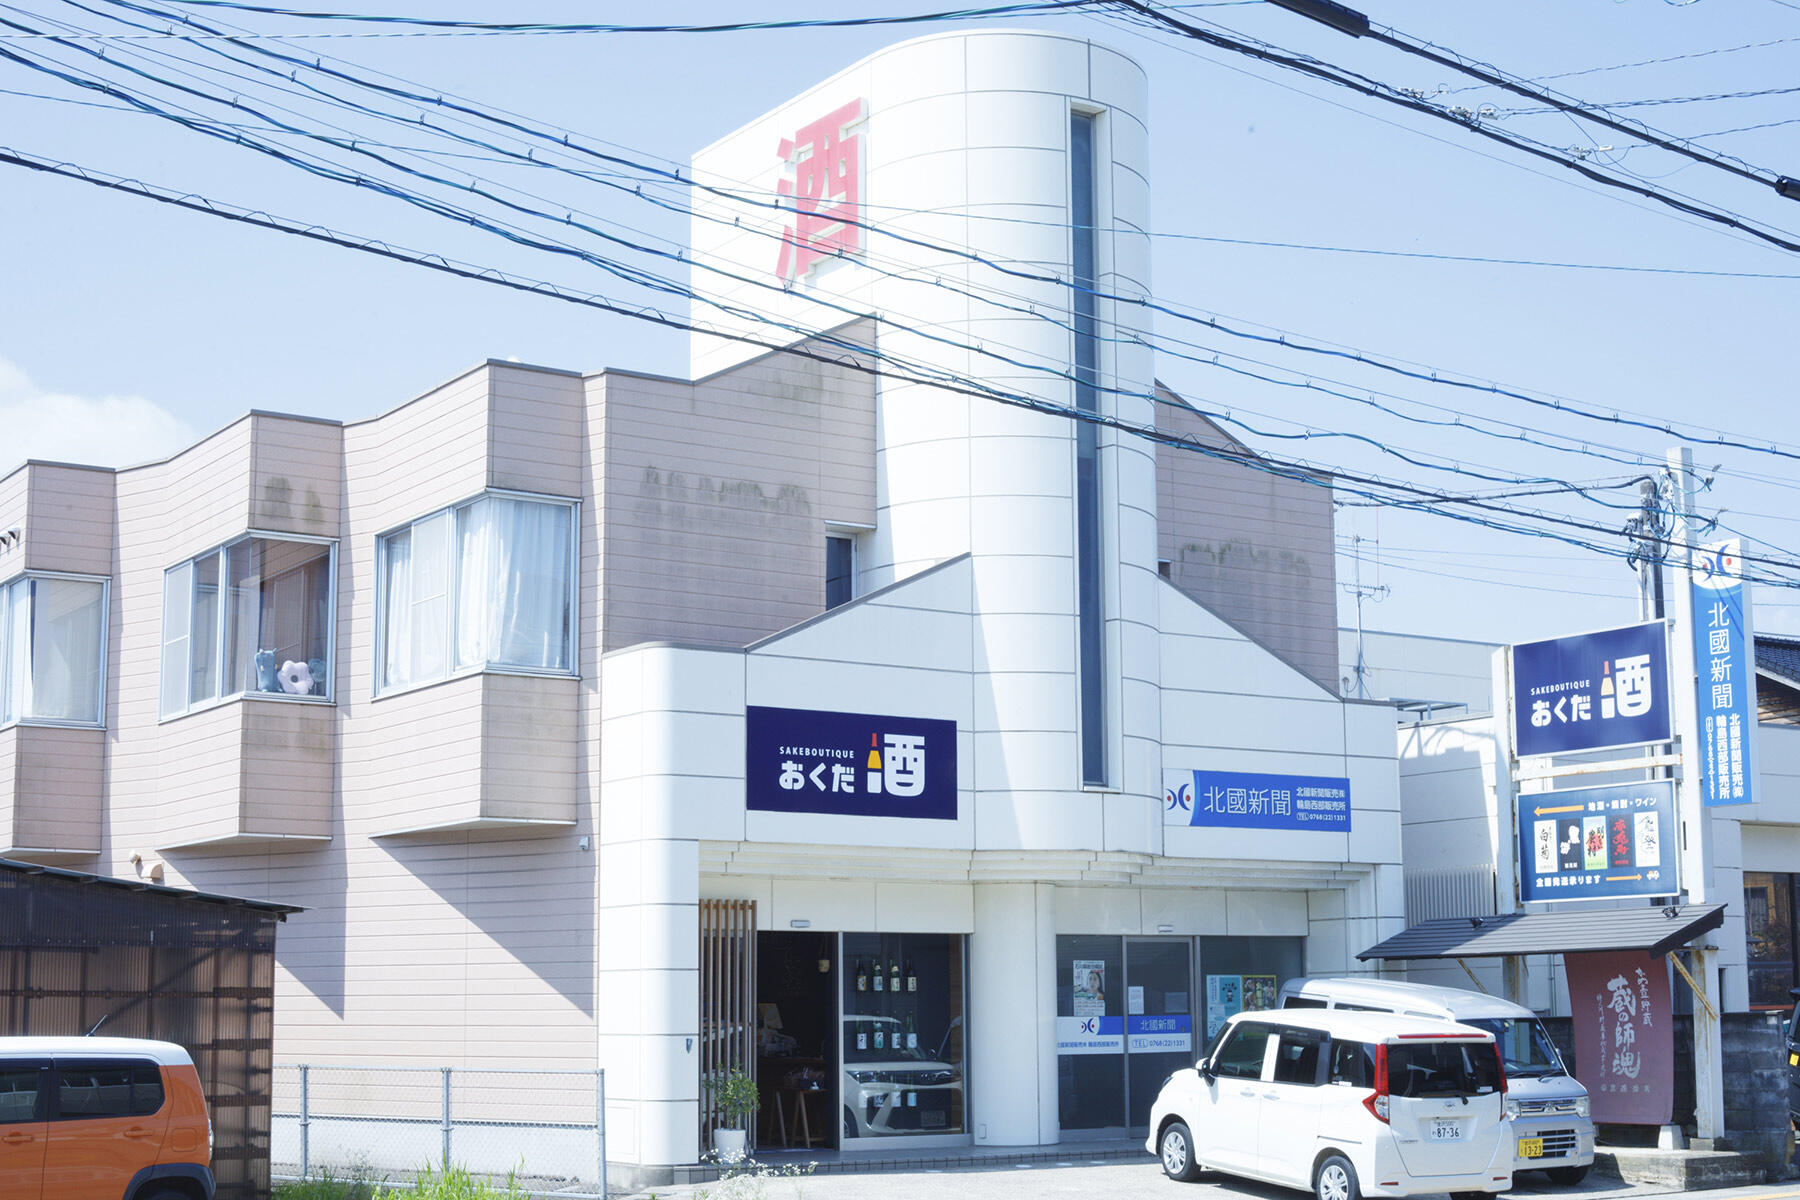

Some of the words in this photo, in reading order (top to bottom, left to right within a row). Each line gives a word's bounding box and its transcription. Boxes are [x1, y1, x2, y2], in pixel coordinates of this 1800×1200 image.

[776, 97, 863, 286] 酒
[1707, 601, 1733, 710] 北國新聞
[1530, 679, 1590, 696] SAKEBOUTIQUE
[1530, 694, 1592, 727] おくだ
[779, 746, 855, 759] SAKEBOUTIQUE
[779, 760, 855, 793] おくだ
[1203, 785, 1292, 816] 北國新聞
